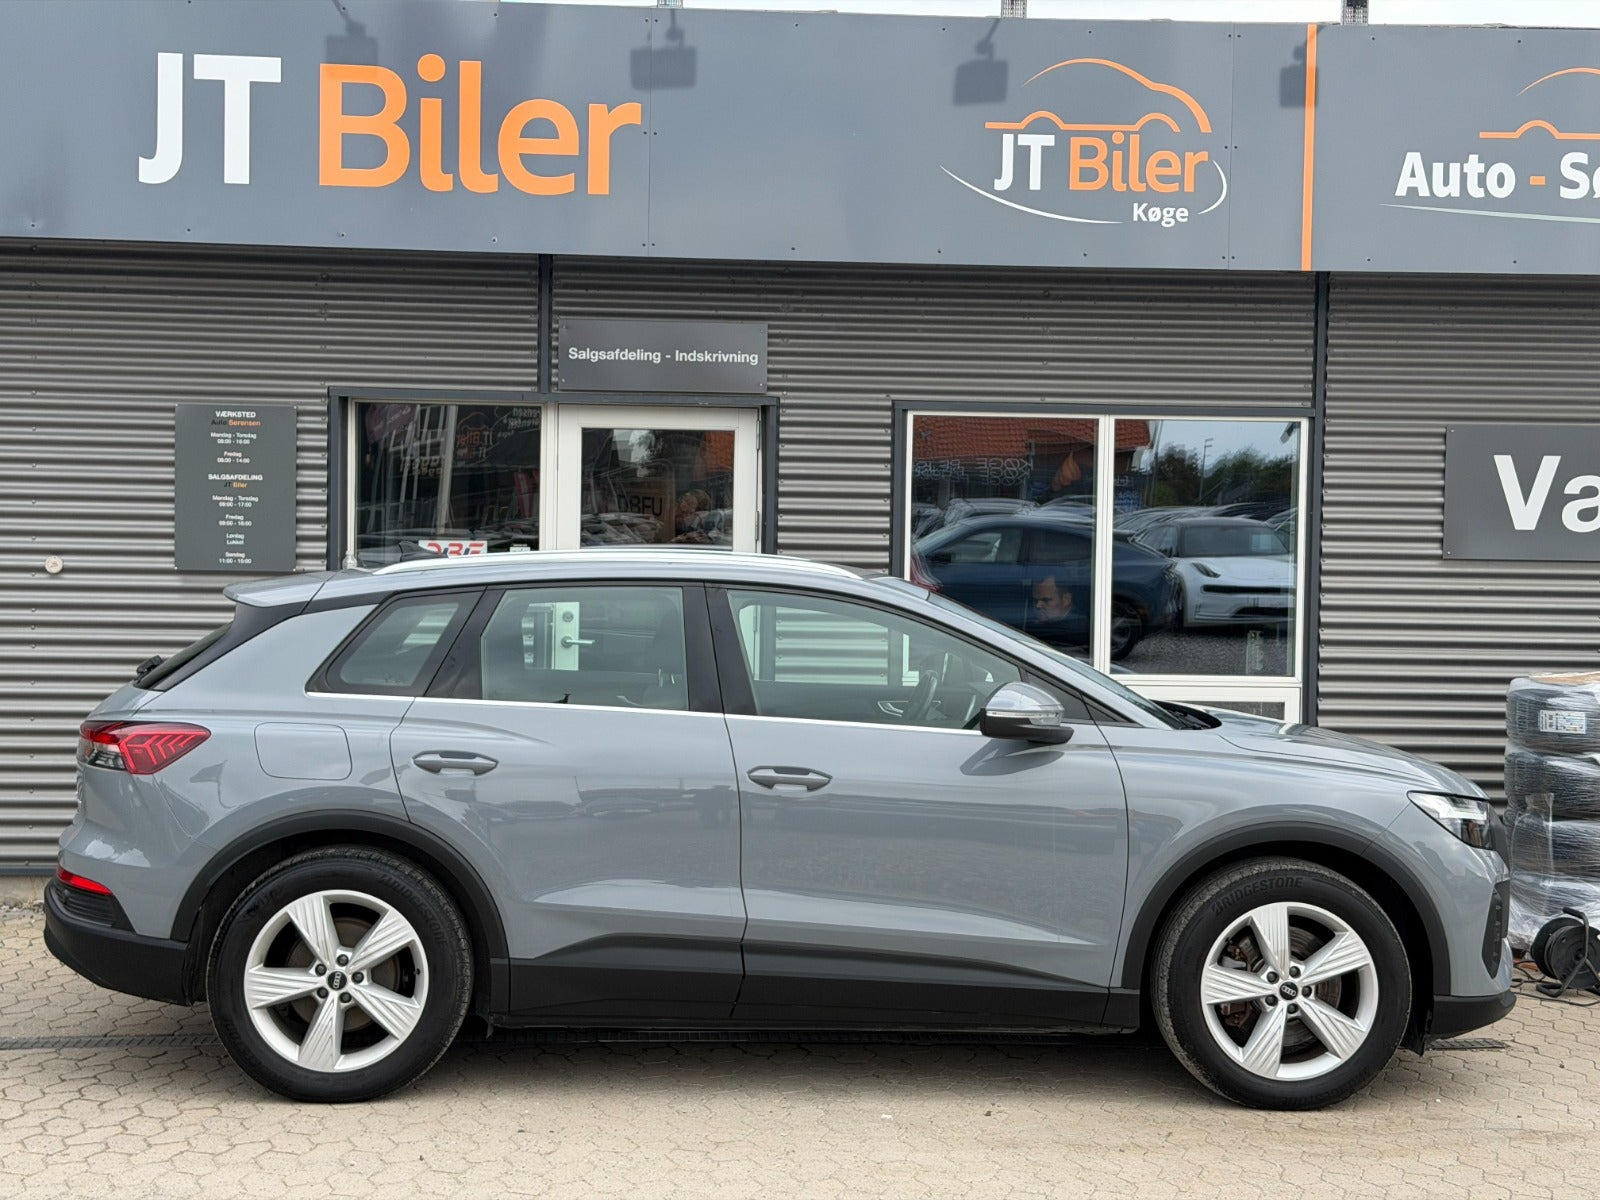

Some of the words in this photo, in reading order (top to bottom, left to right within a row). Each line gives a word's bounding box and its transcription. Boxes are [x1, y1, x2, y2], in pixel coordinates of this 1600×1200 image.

[138, 52, 281, 185] JT
[319, 53, 642, 196] Biler
[993, 133, 1056, 191] JT
[1069, 131, 1209, 193] Biler
[1395, 152, 1516, 199] Auto
[1559, 151, 1600, 200] S
[1133, 202, 1189, 228] Køge
[568, 347, 661, 364] Salgsafdeling
[675, 350, 758, 366] Indskrivning
[215, 410, 256, 418] VÆRKSTED
[208, 473, 263, 481] SALGSAFDELING
[1493, 454, 1600, 533] Va
